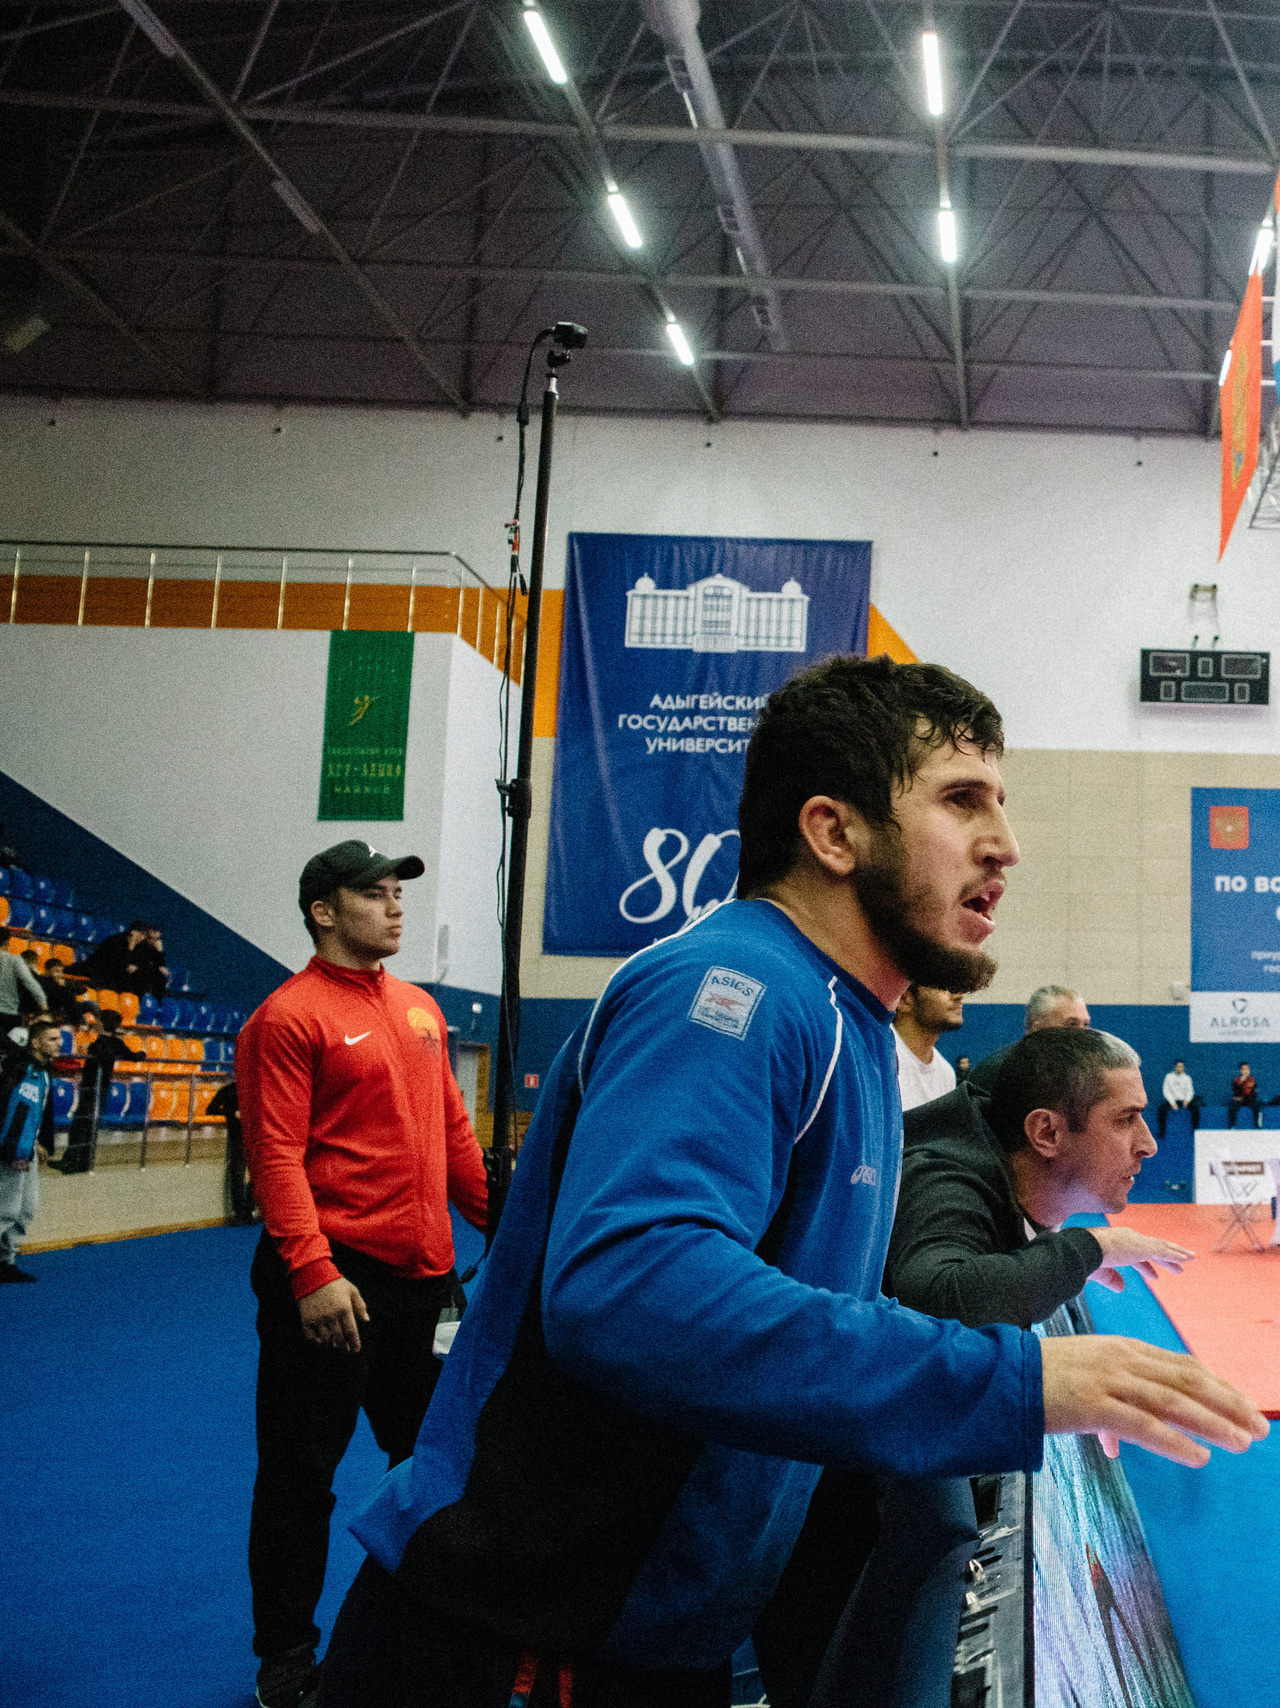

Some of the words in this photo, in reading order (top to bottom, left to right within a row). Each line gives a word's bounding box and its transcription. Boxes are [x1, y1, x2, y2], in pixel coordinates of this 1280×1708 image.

[1215, 876, 1246, 893] по
[711, 976, 754, 997] ASICS
[1210, 1017, 1270, 1028] ALROSA
